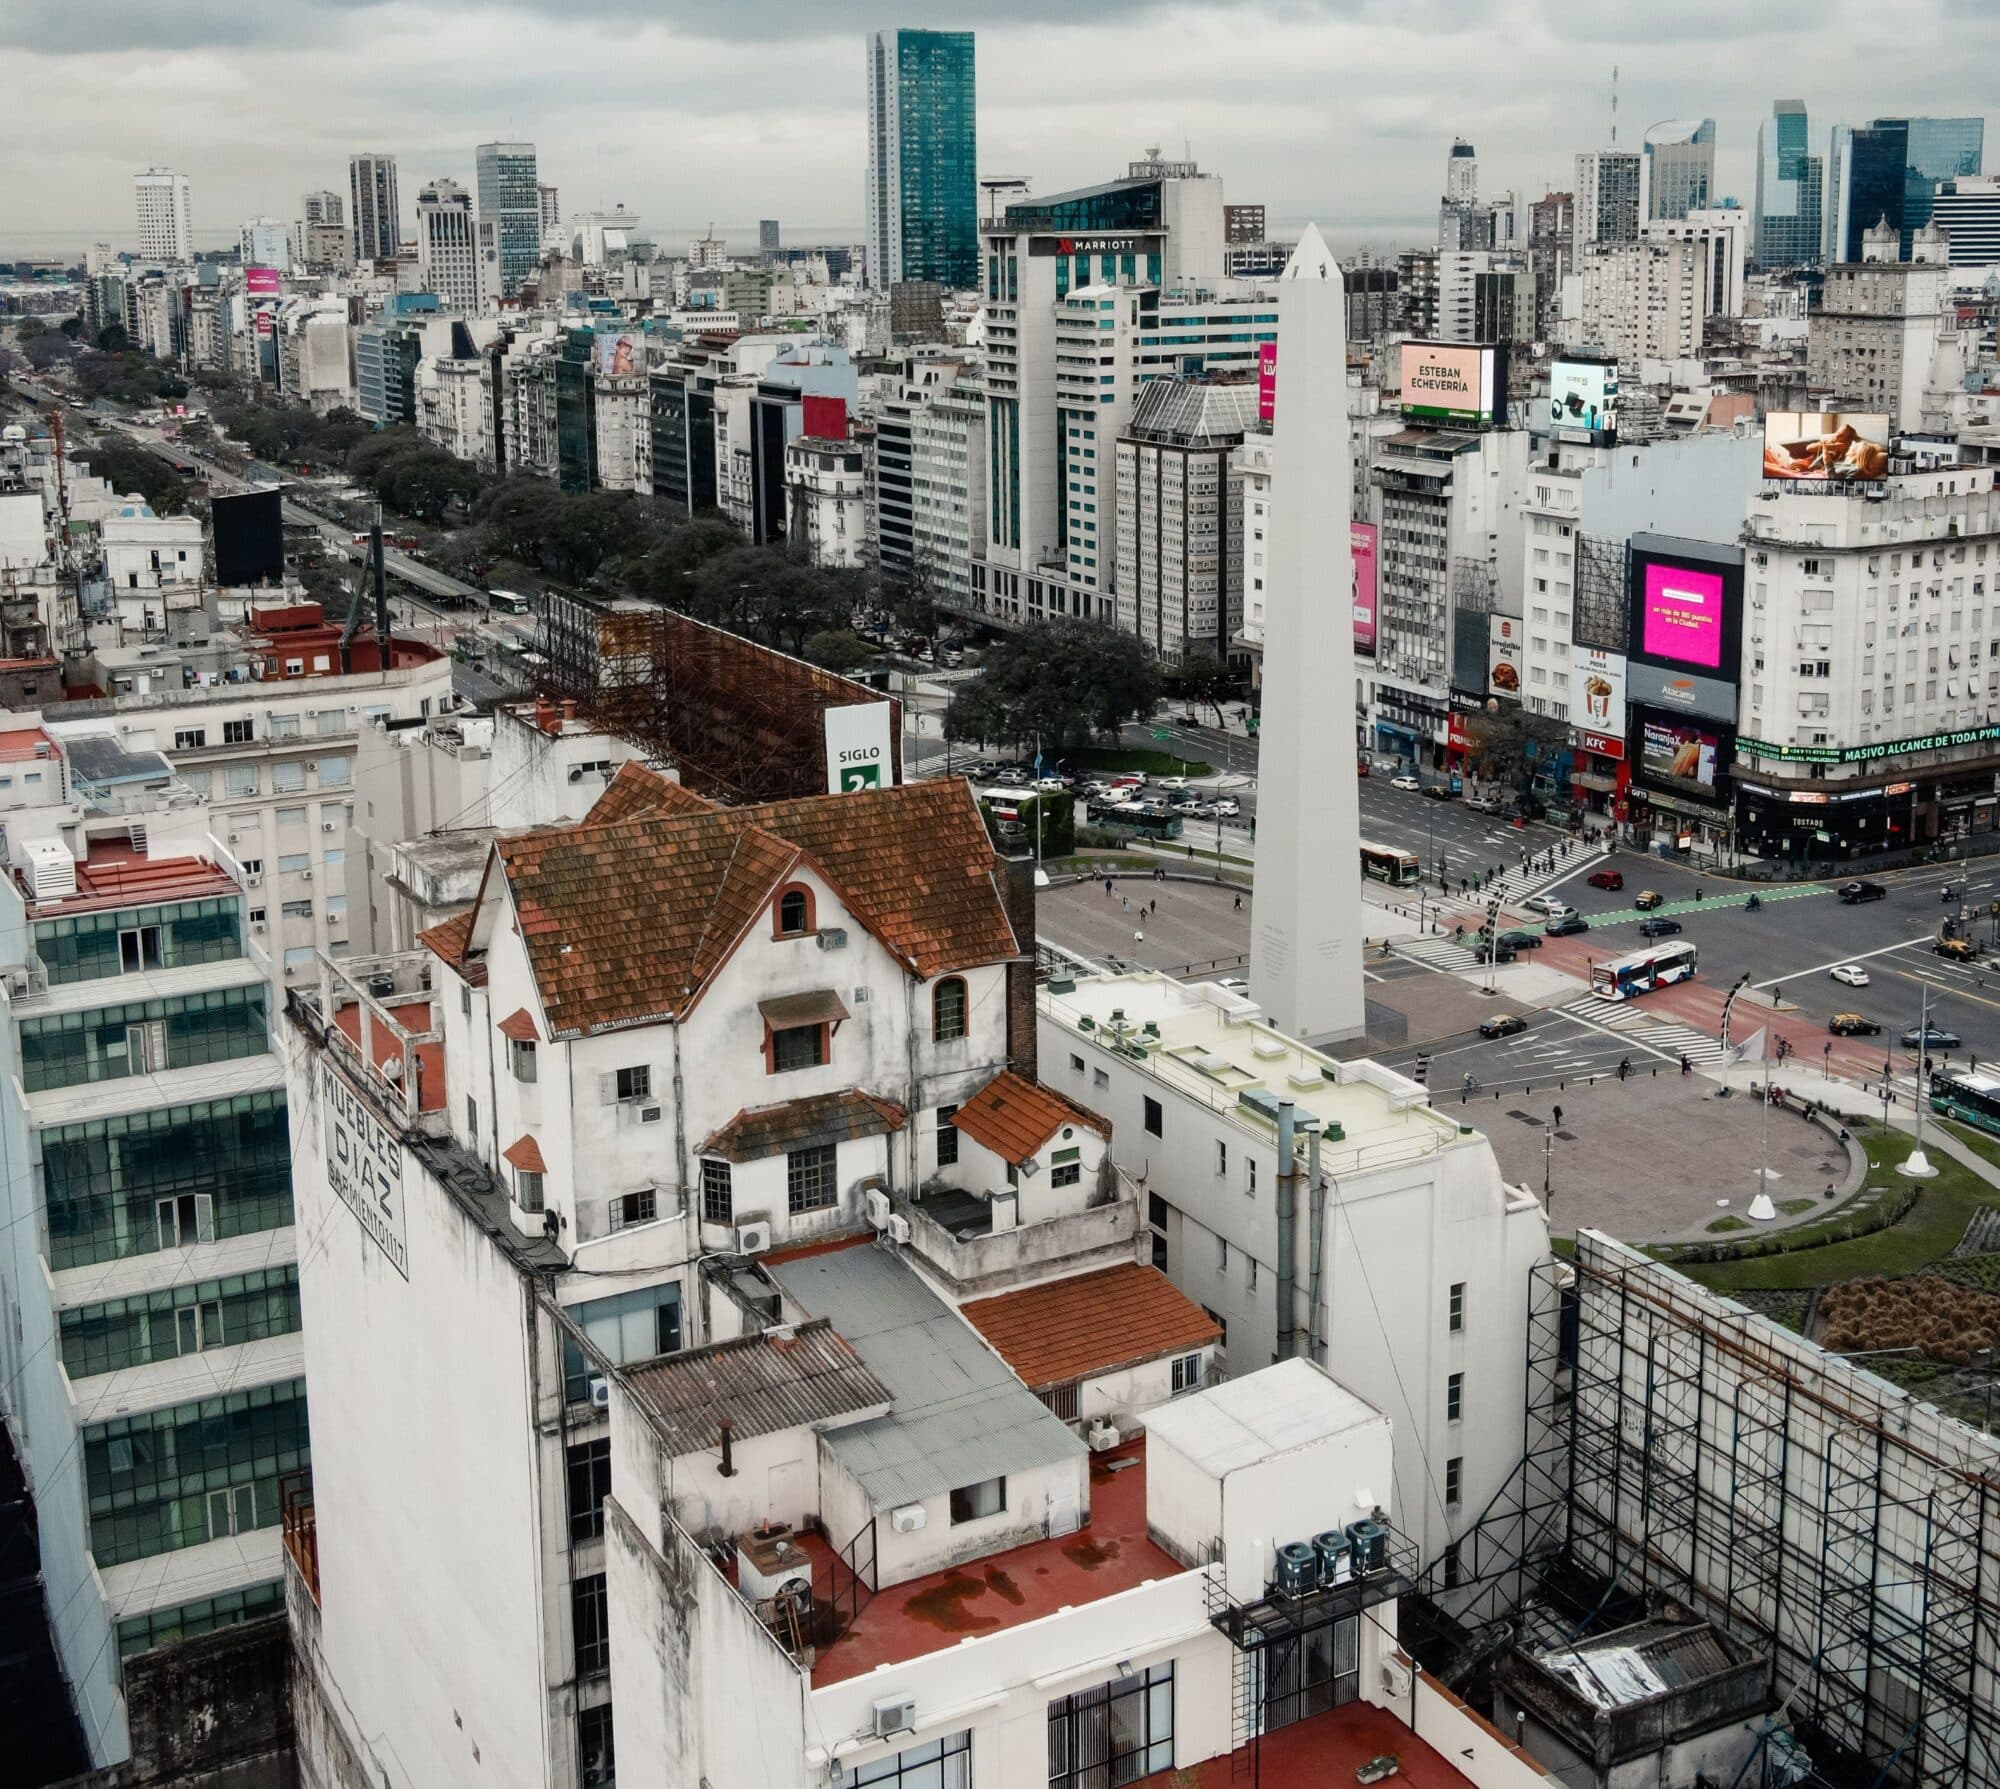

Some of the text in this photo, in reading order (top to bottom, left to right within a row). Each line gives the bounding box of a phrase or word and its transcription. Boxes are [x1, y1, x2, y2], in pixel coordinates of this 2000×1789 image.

[1075, 240, 1134, 250] MARRIOTT
[1419, 365, 1461, 378] ESTEBAN
[1411, 377, 1468, 392] ECHEVERRÍA
[1450, 691, 1459, 703] La
[1662, 685, 1696, 701] Atacama
[1586, 736, 1606, 750] KFC
[1845, 746, 1885, 761] MASIVO
[1887, 738, 1933, 755] ALCANCE
[1935, 736, 1949, 747] DE
[1951, 731, 1977, 745] TODA
[839, 747, 880, 763] SIGLO
[323, 1067, 400, 1181] MUEBLES
[335, 1121, 393, 1220] DIAZ
